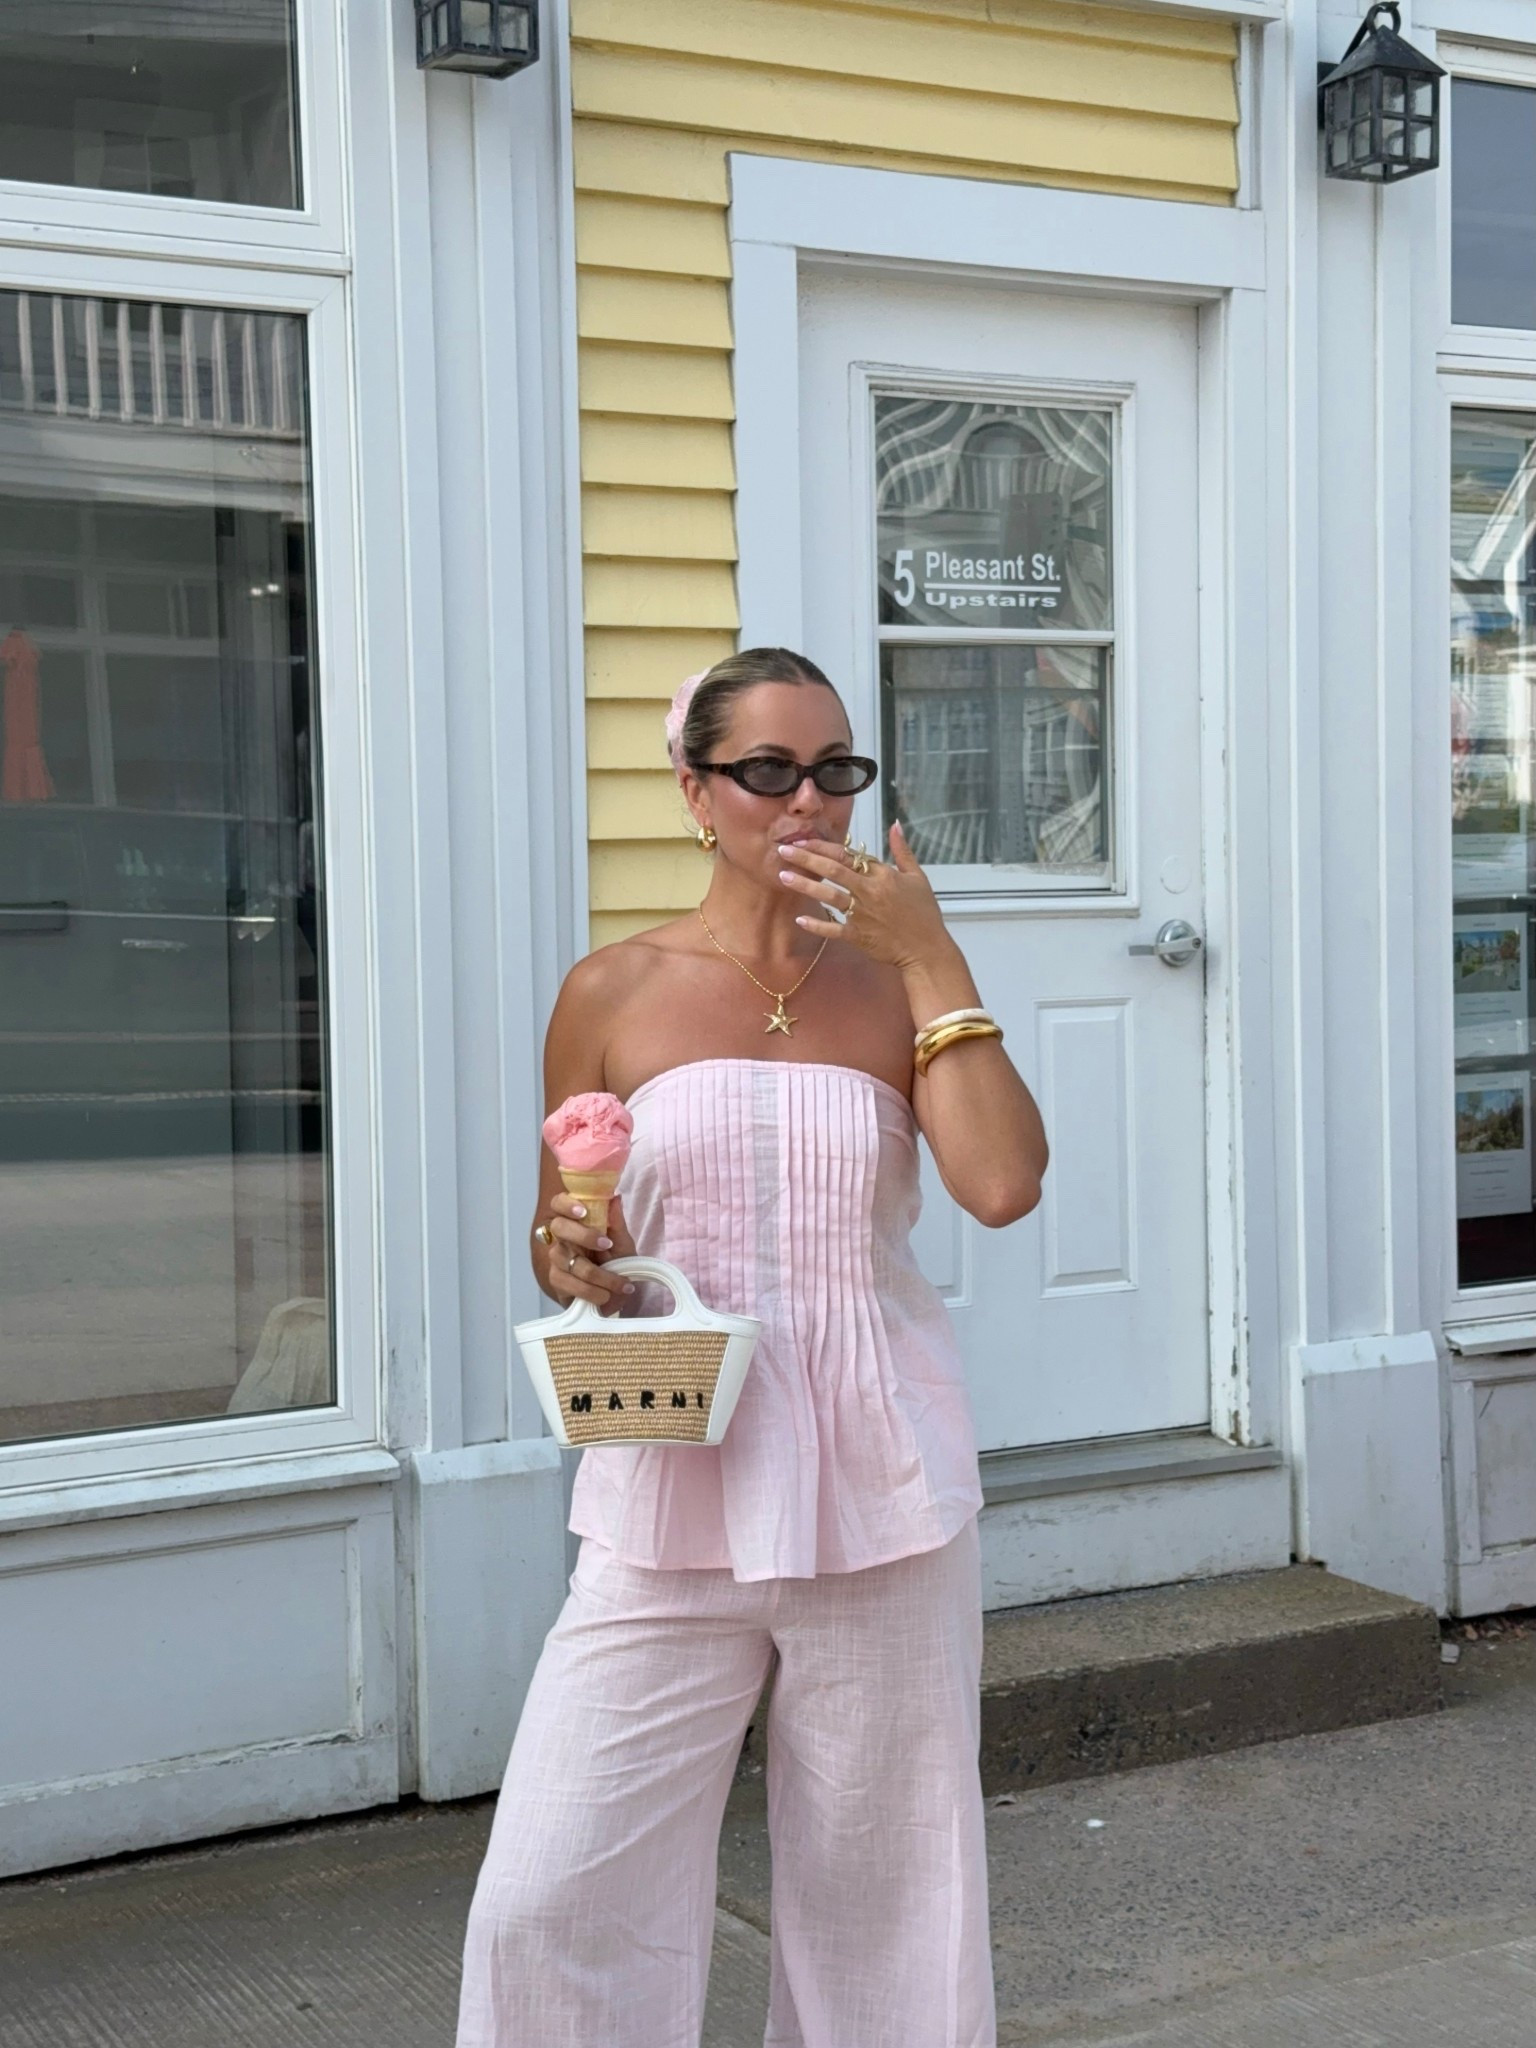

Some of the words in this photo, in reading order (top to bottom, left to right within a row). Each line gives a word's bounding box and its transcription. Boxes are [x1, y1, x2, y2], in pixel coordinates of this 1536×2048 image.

[894, 549, 916, 607] 5
[926, 551, 1025, 580] Pleasant
[1031, 553, 1061, 581] St.
[925, 592, 1057, 609] Upstairs
[570, 1391, 704, 1413] MARNI
